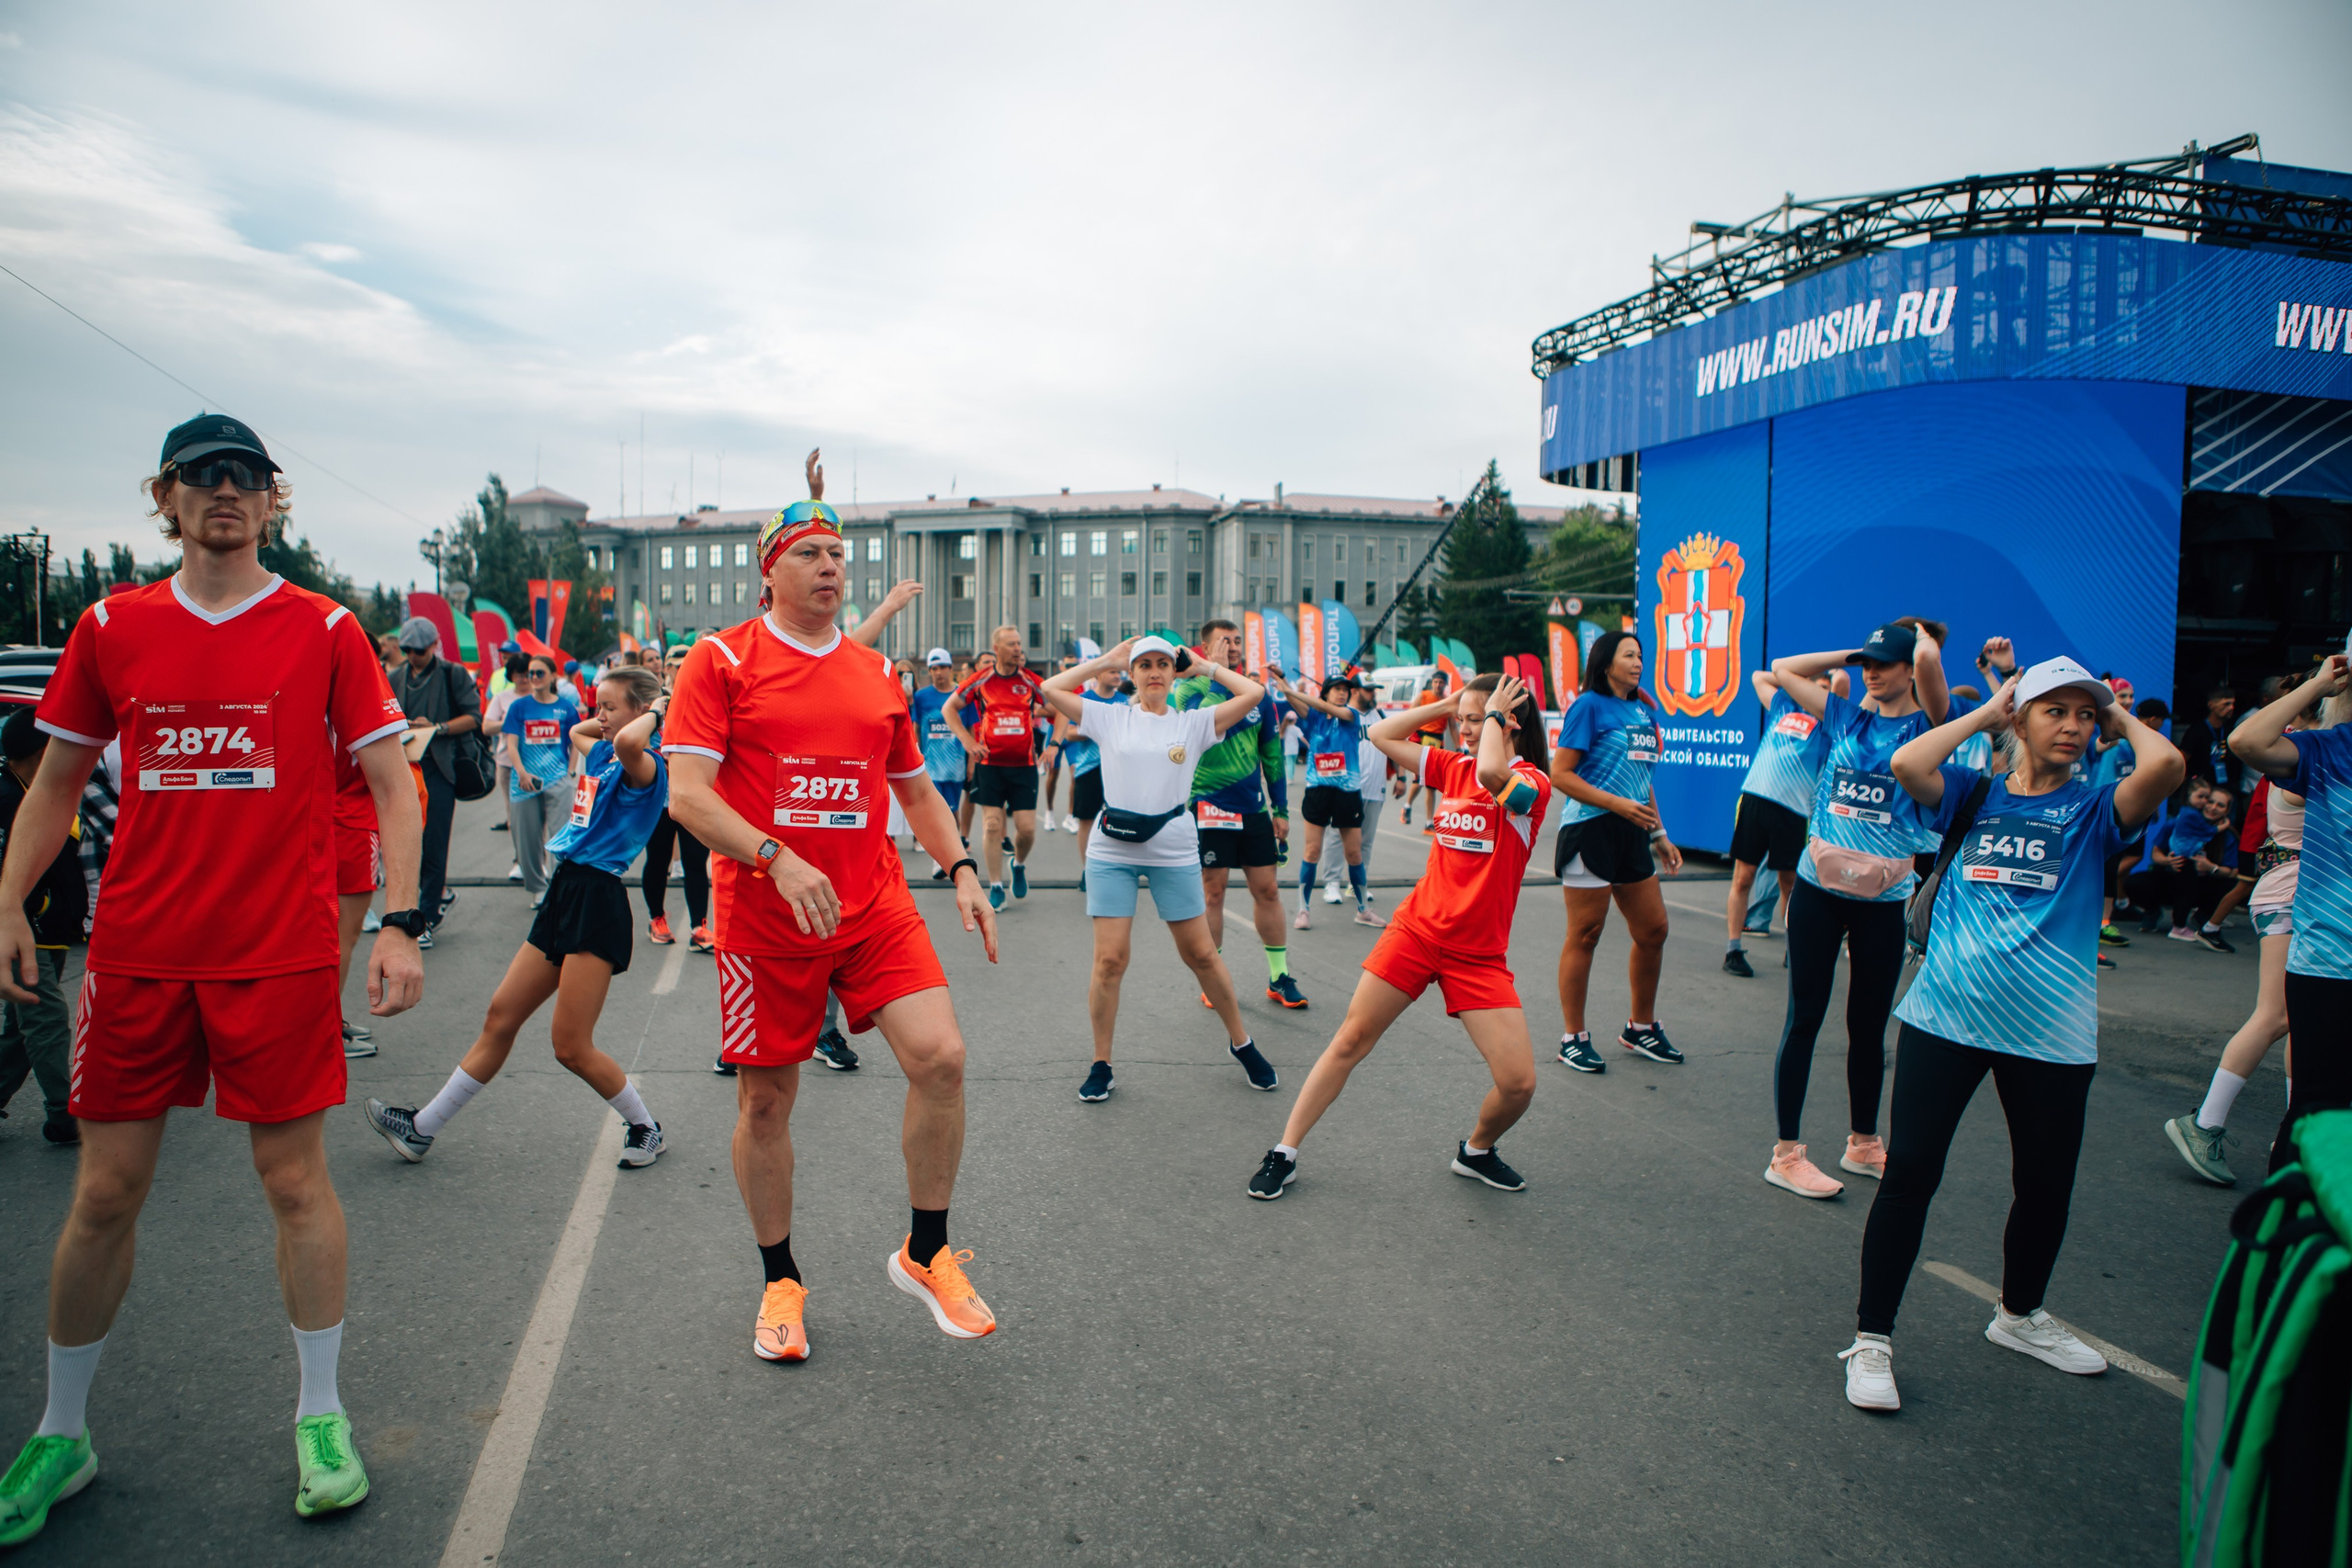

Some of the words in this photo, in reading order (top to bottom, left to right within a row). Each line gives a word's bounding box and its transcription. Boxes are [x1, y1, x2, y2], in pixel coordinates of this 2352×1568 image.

[2275, 301, 2352, 355] WW
[1696, 287, 1958, 398] WWW.RUNSIM.RU
[155, 727, 255, 755] 2874
[1632, 733, 1657, 748] 3069
[1660, 728, 1744, 744] РАВИТЕЛЬСТВО
[1697, 752, 1749, 768] ОБЛАСТИ
[790, 775, 859, 801] 2873
[1838, 780, 1885, 804] 5420
[1106, 824, 1136, 834] Champion
[1440, 811, 1487, 832] 2080
[1976, 834, 2046, 861] 5416
